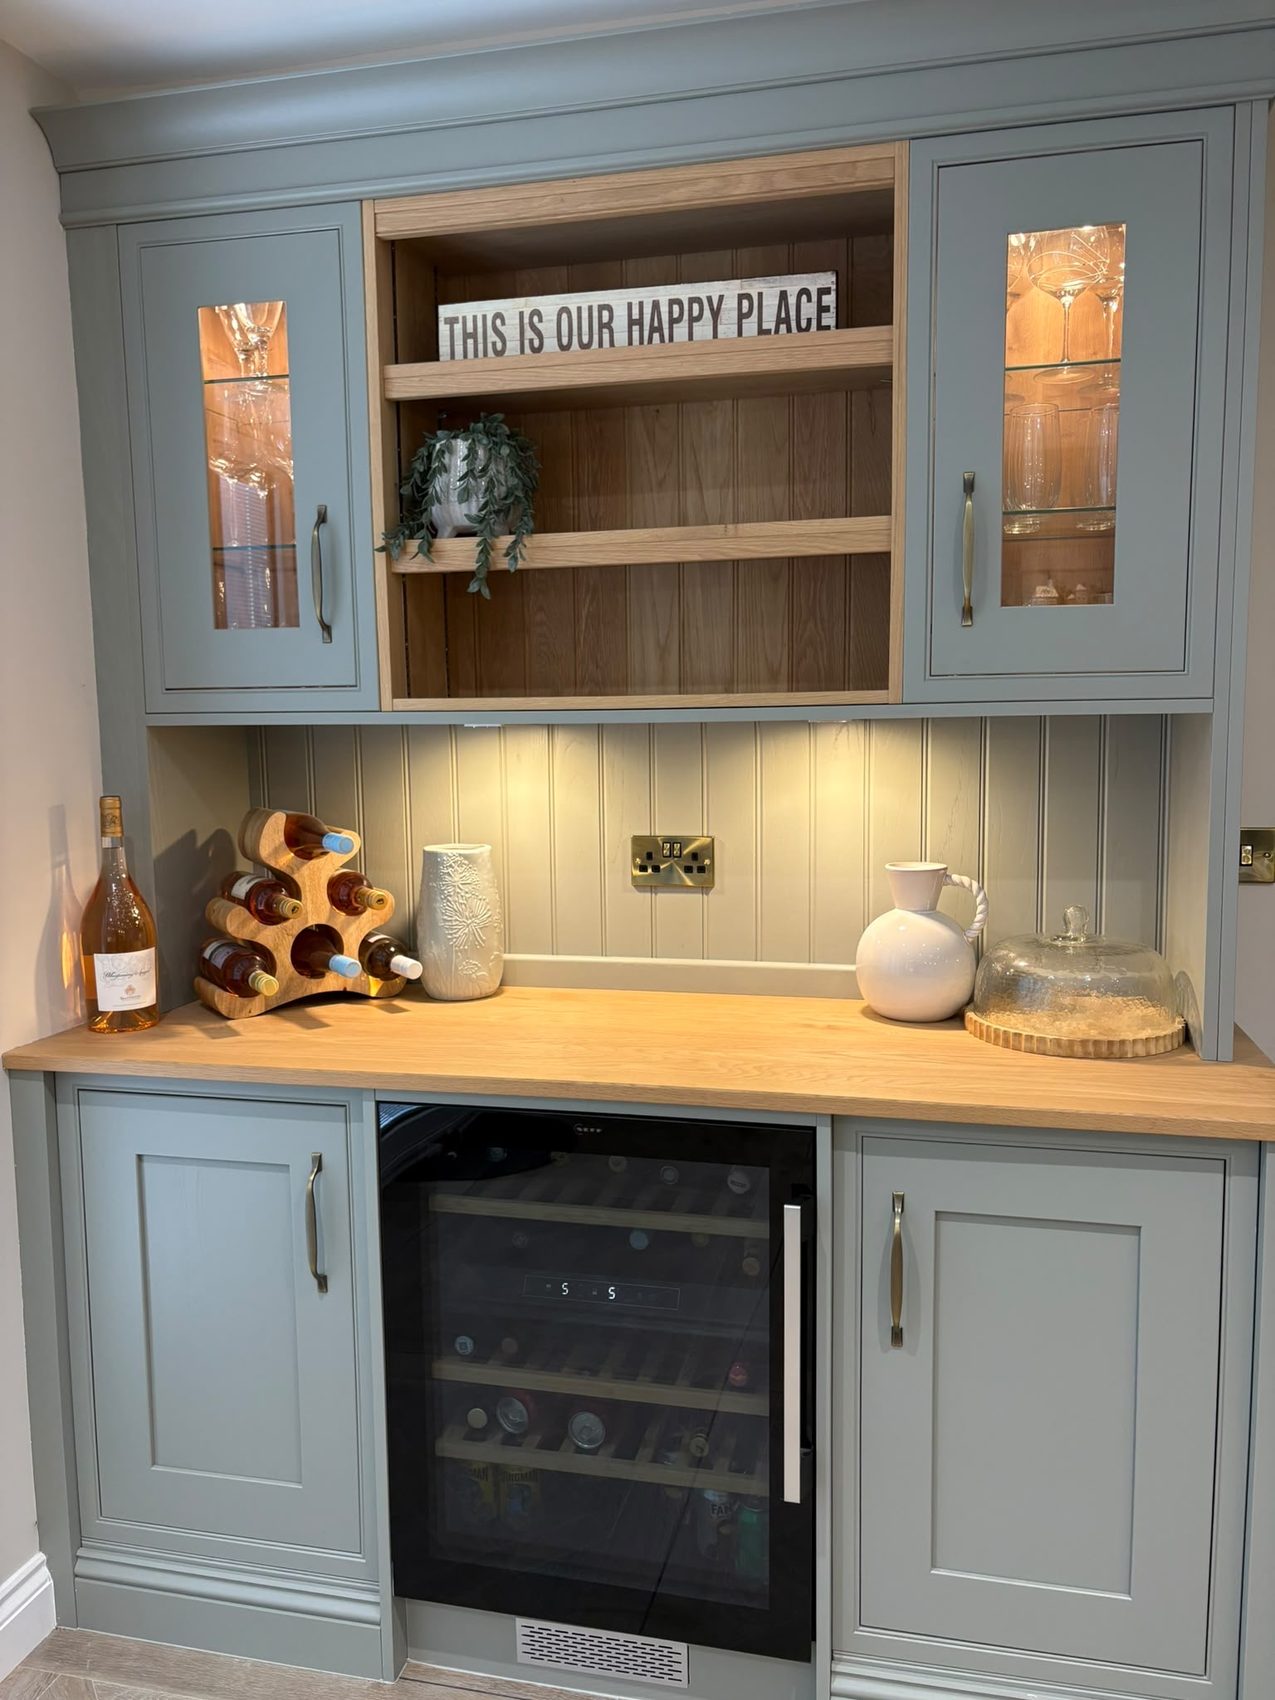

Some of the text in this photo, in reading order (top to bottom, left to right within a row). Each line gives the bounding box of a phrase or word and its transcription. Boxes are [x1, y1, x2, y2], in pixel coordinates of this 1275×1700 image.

[443, 286, 832, 361] THIS IS OUR HAPPY PLACE
